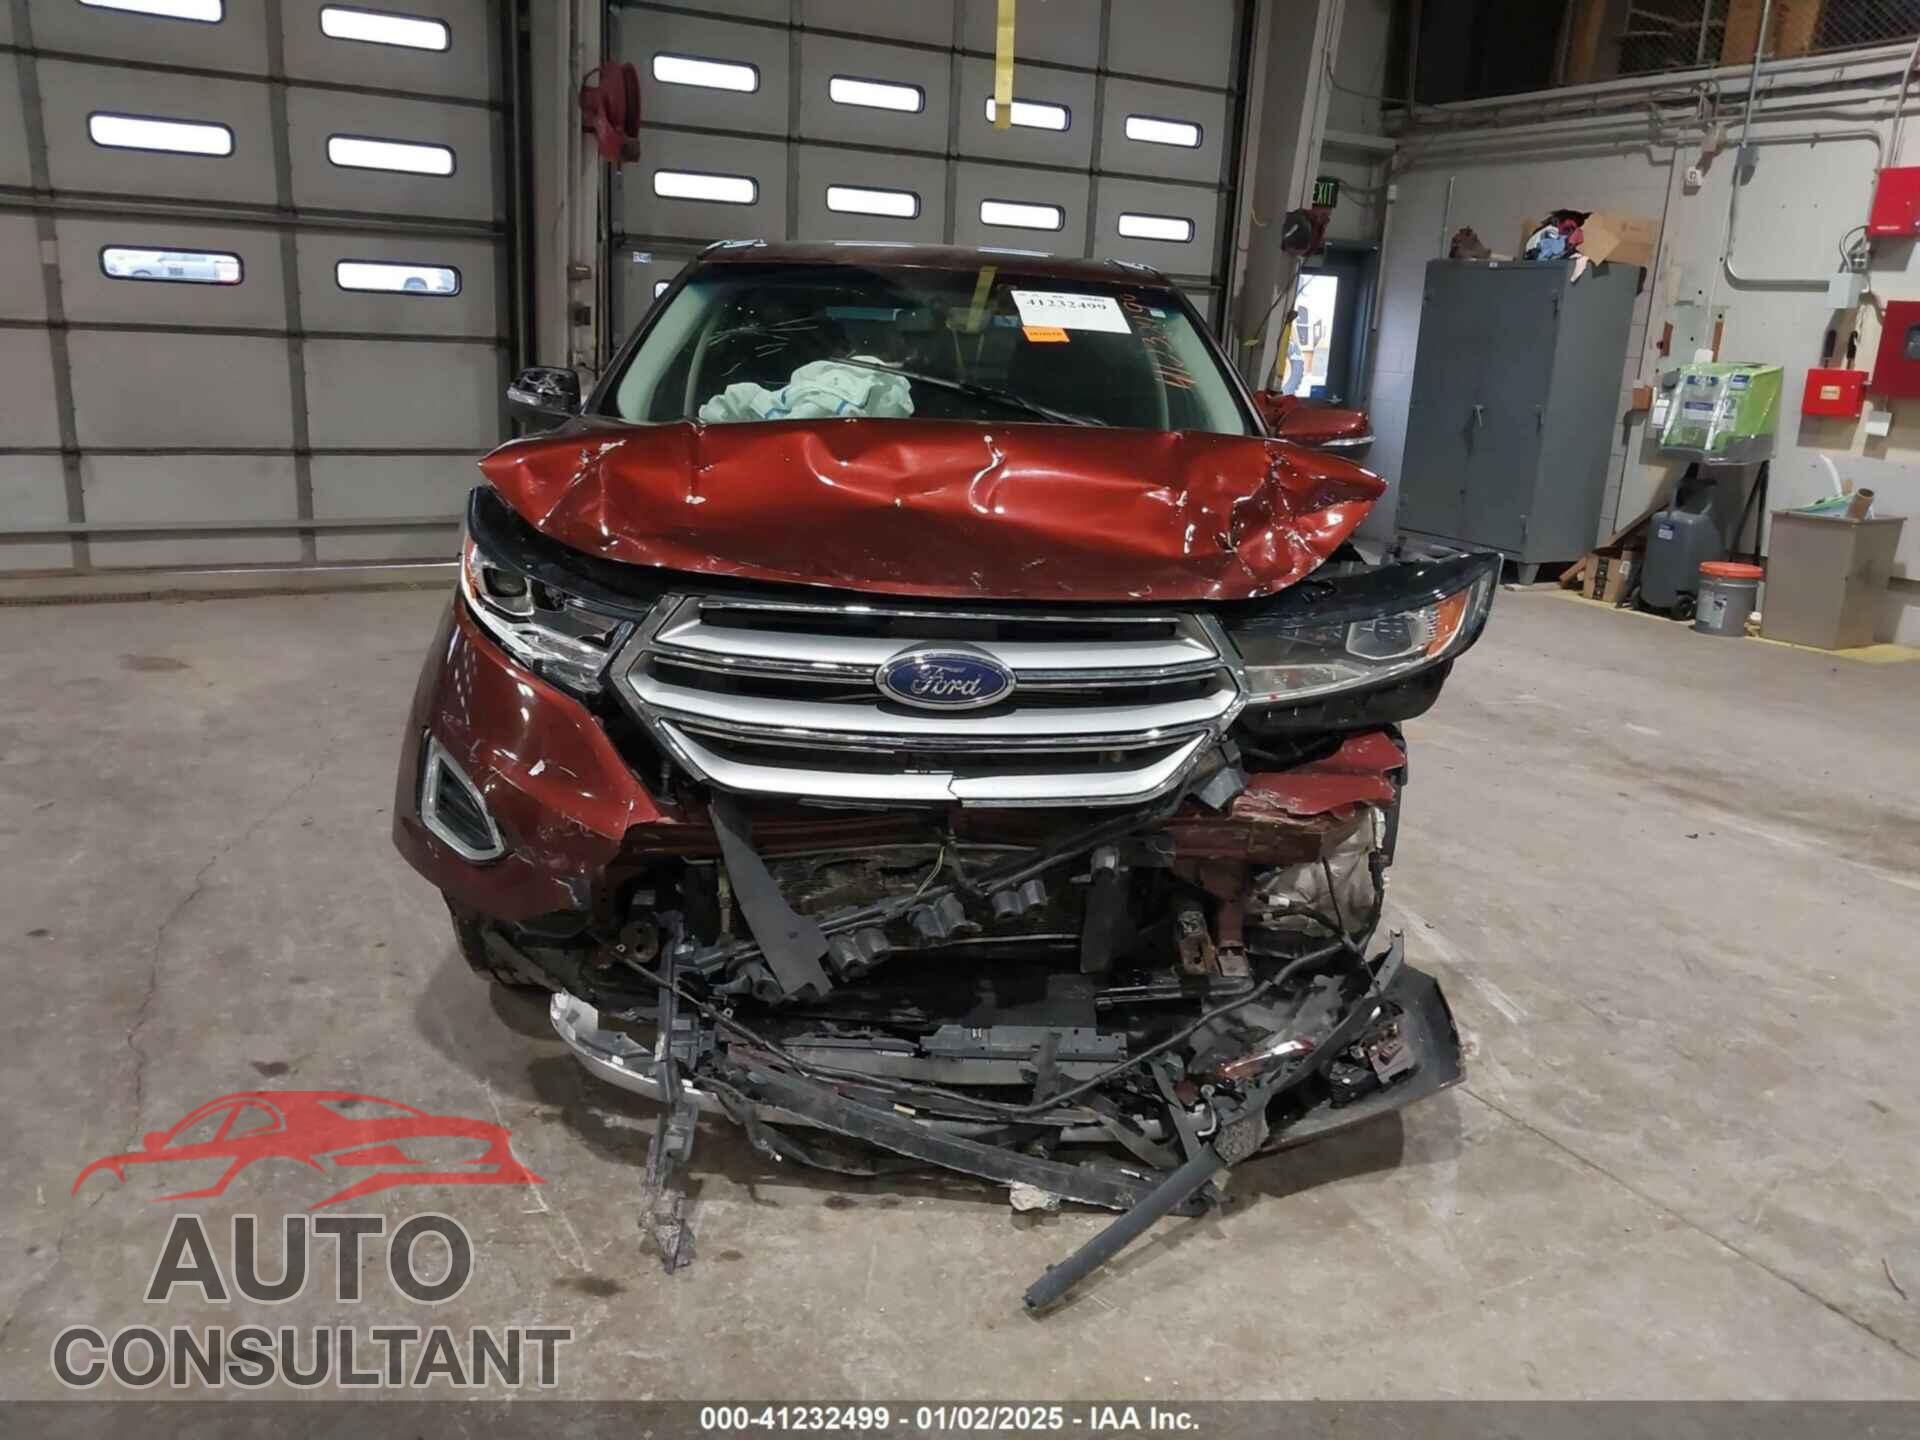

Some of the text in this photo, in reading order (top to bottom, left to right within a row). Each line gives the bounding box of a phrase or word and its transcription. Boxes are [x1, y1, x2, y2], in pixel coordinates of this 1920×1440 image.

[1312, 182, 1335, 204] EXIT
[1026, 297, 1108, 311] 41232499
[910, 664, 983, 697] Ford
